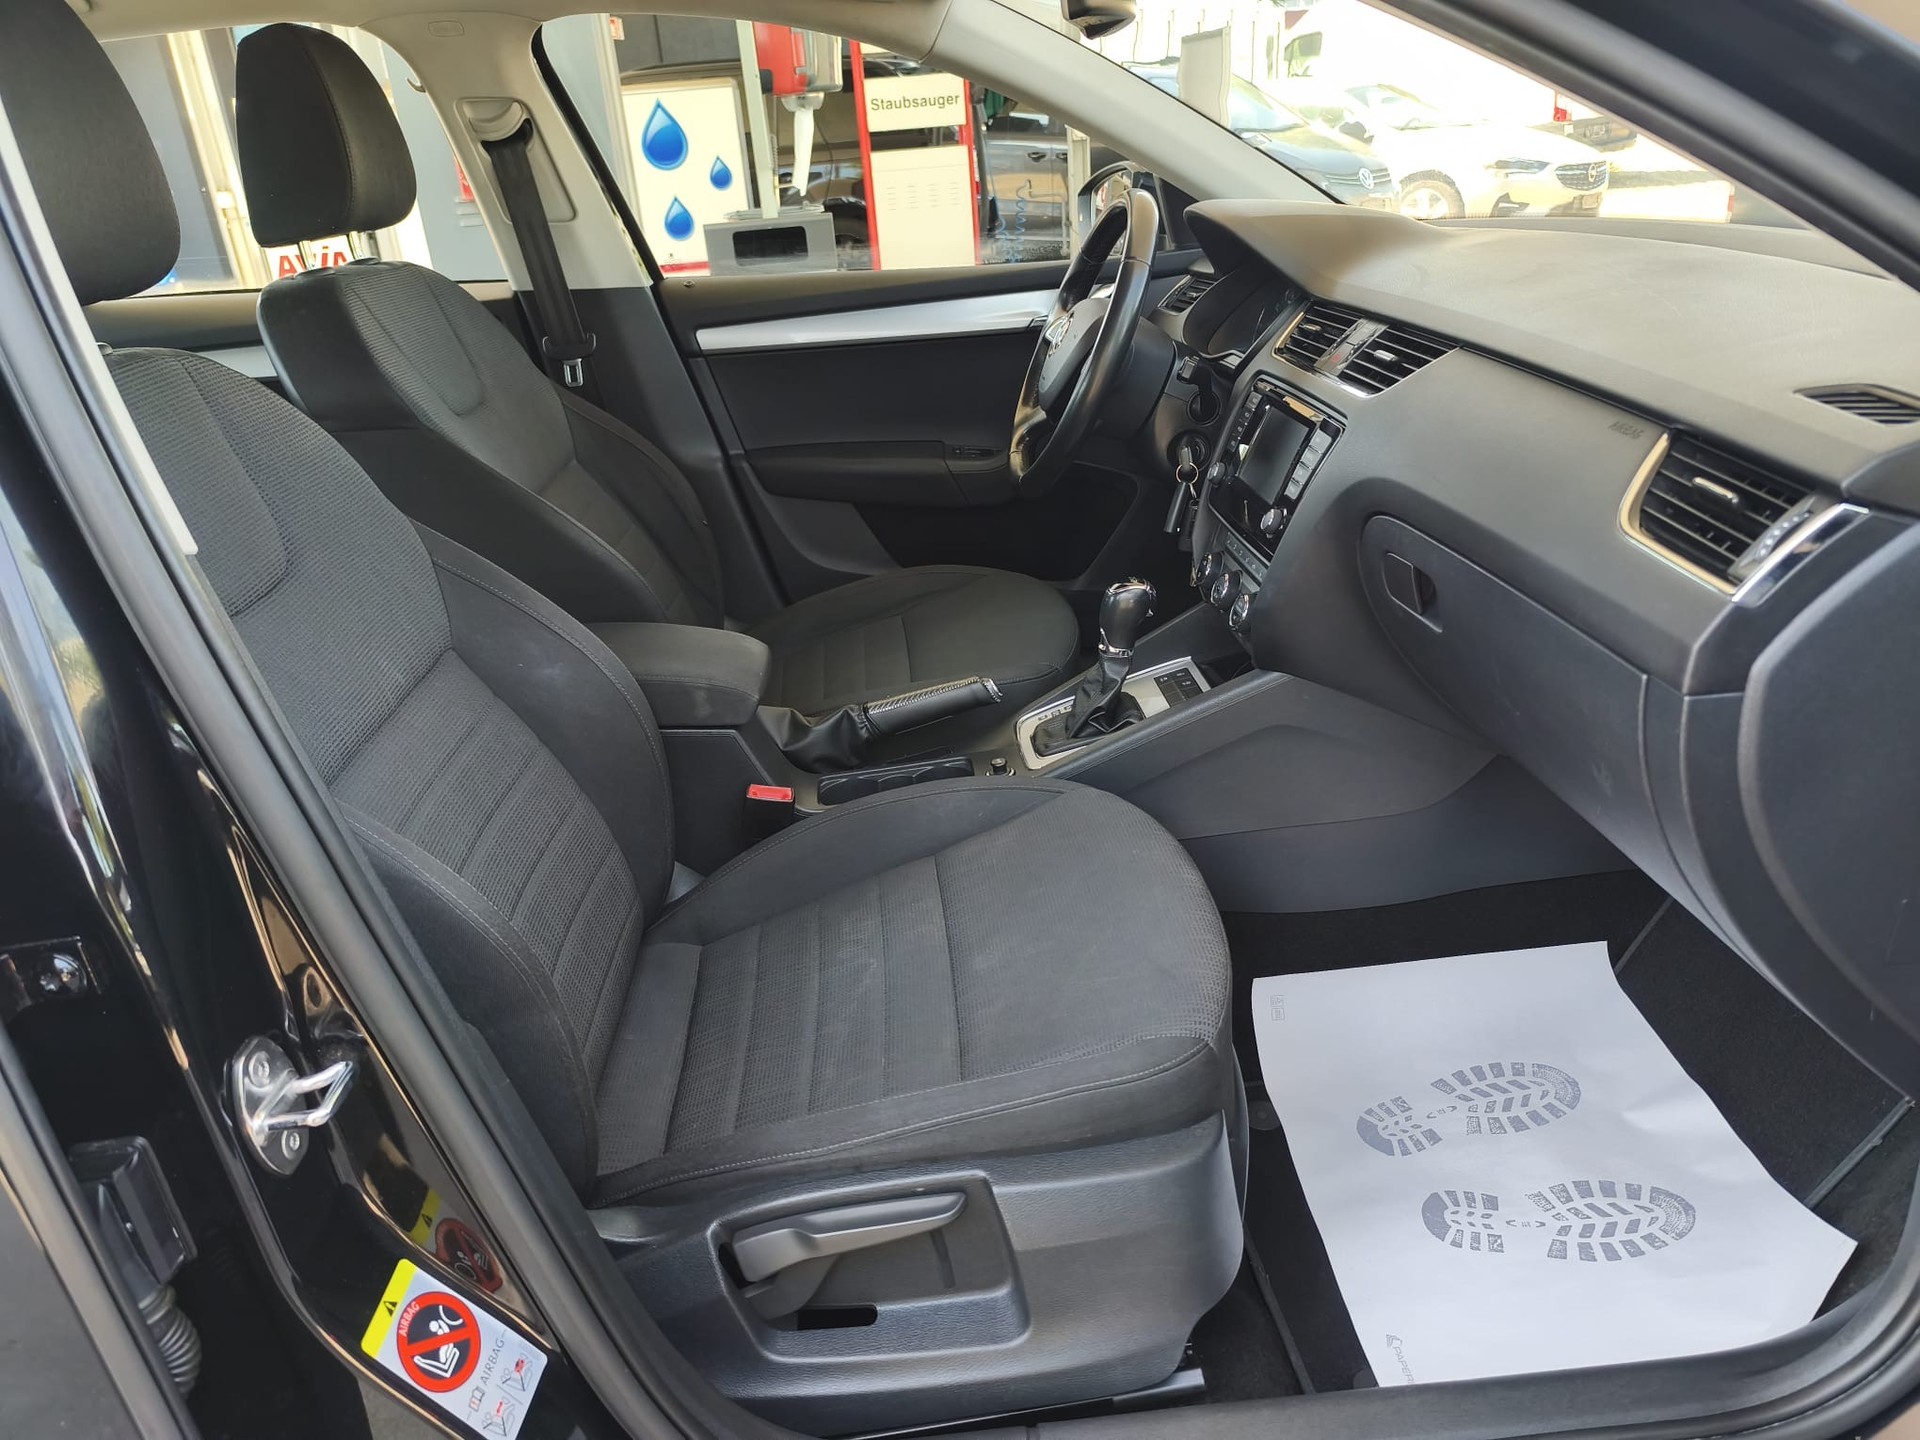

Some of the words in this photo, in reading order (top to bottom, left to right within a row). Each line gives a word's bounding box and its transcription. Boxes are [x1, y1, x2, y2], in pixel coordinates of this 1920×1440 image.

[870, 94, 960, 111] Staubsauger
[398, 1301, 420, 1337] AIRBAG
[480, 1337, 505, 1386] AIRBAG
[1392, 1346, 1416, 1384] PAPER
